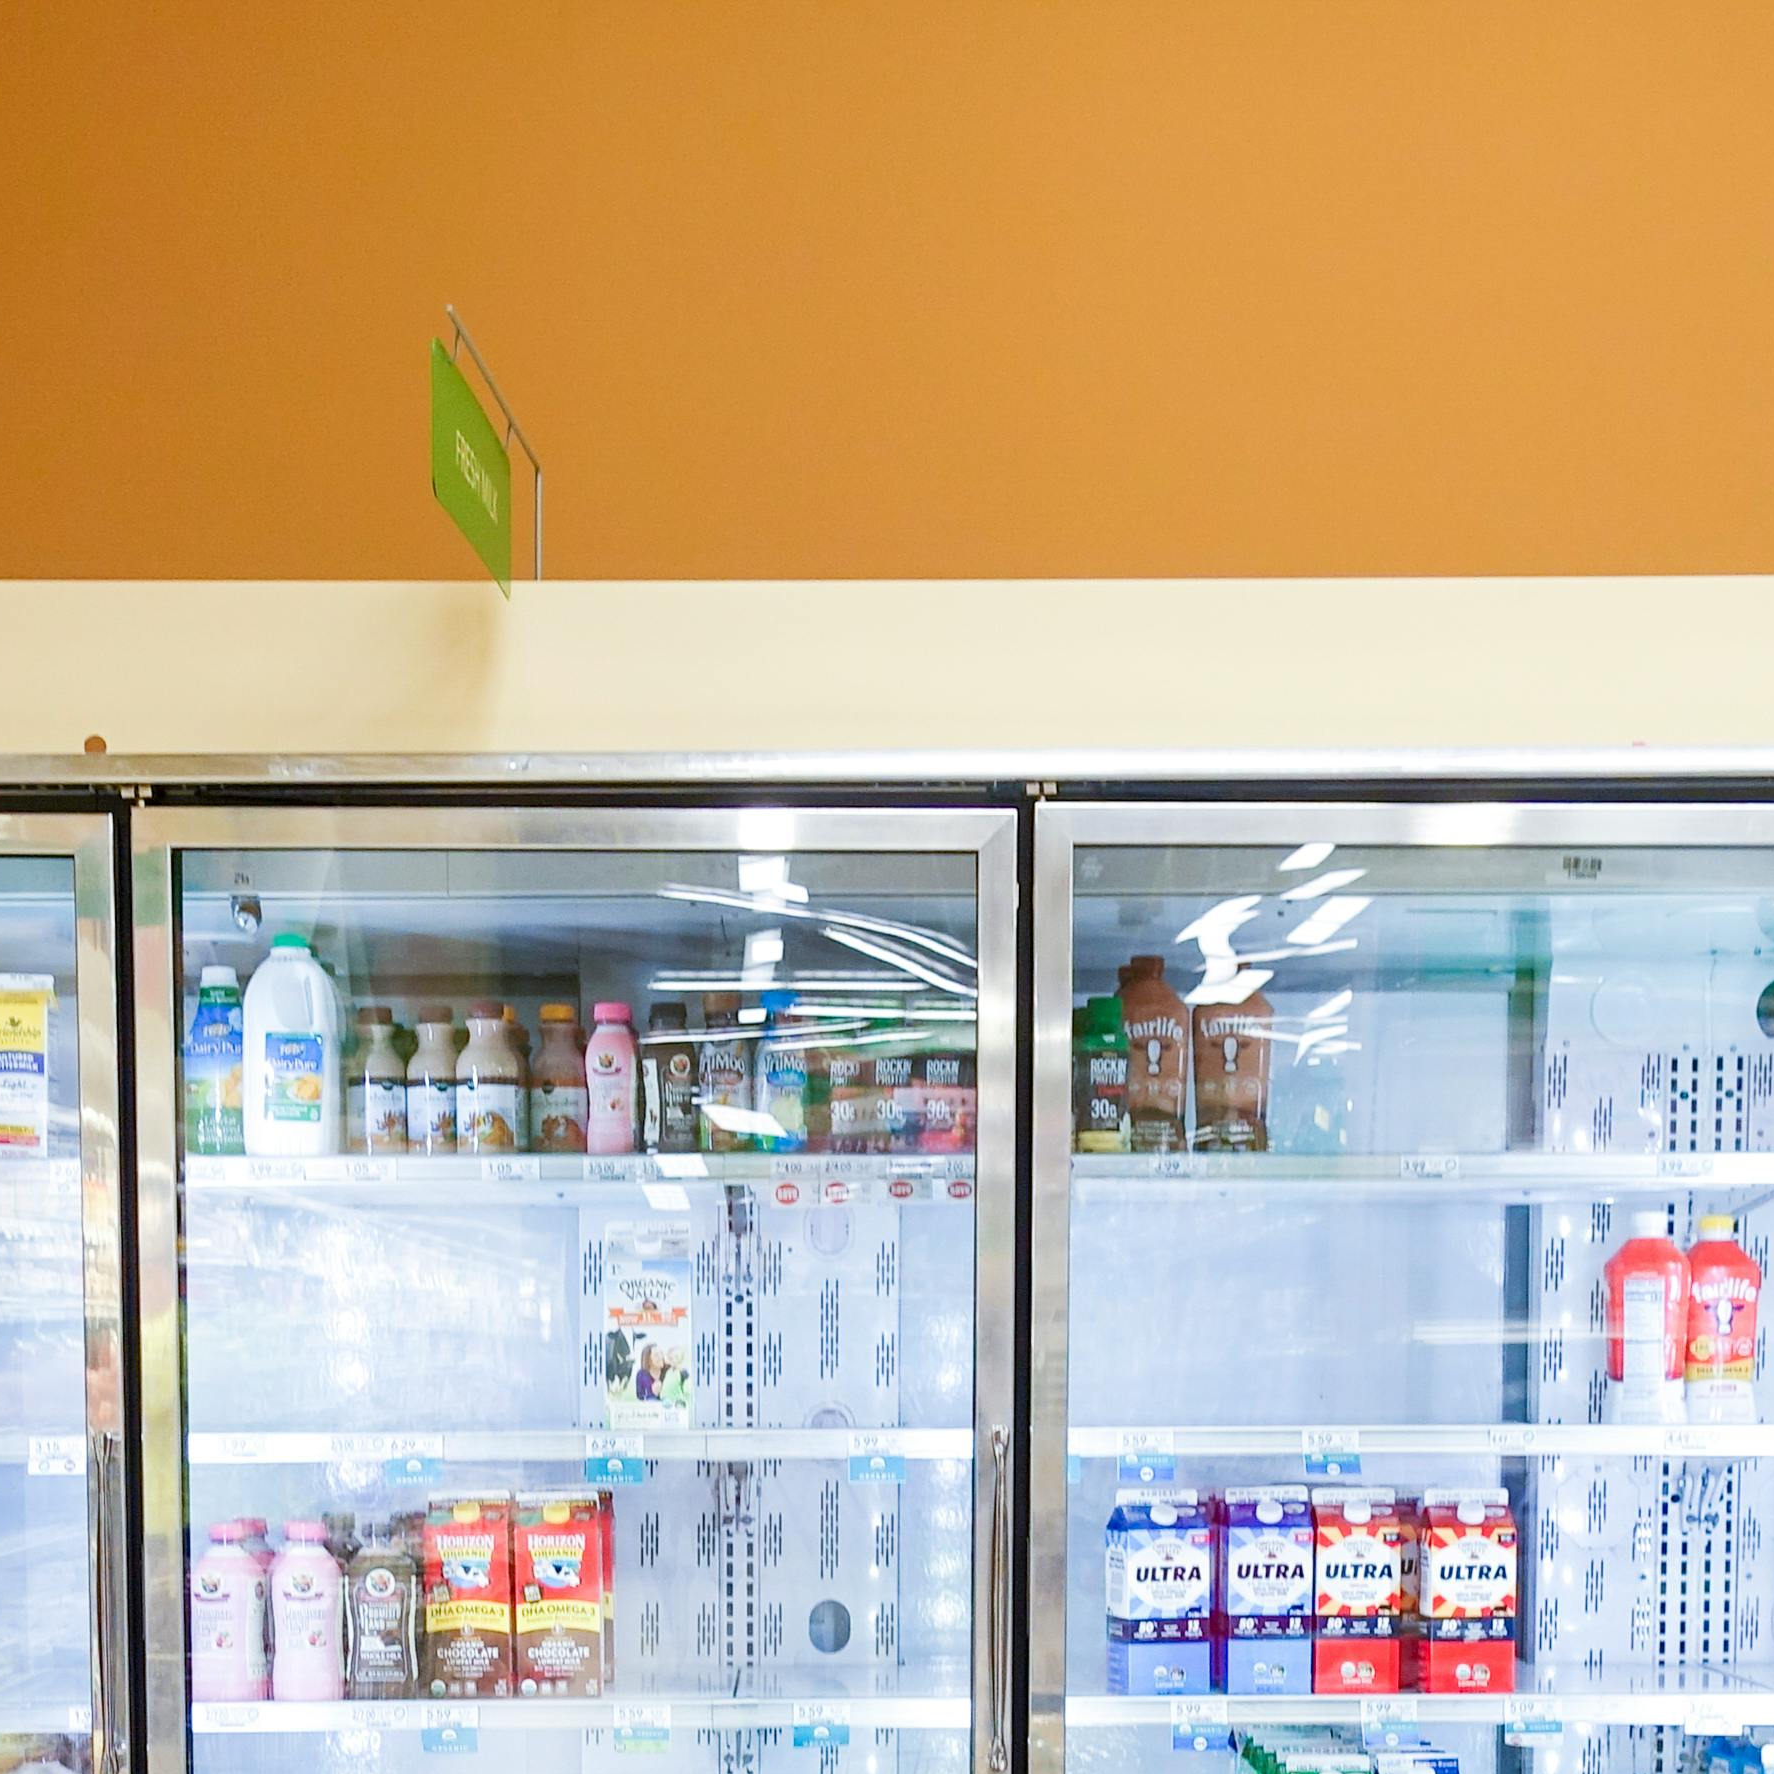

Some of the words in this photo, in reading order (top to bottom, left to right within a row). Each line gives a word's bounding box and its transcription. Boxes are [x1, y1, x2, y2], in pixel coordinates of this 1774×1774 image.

[1125, 1018, 1184, 1040] fairlife
[437, 1535, 494, 1549] HORIZON
[528, 1534, 585, 1550] HORIZON
[1136, 1566, 1202, 1583] ULTRA
[1237, 1563, 1305, 1579] ULTRA
[1325, 1563, 1393, 1579] ULTRA
[1439, 1565, 1508, 1581] ULTRA
[437, 1647, 499, 1659] CHOCOLATE
[528, 1647, 589, 1659] CHOCOLATE
